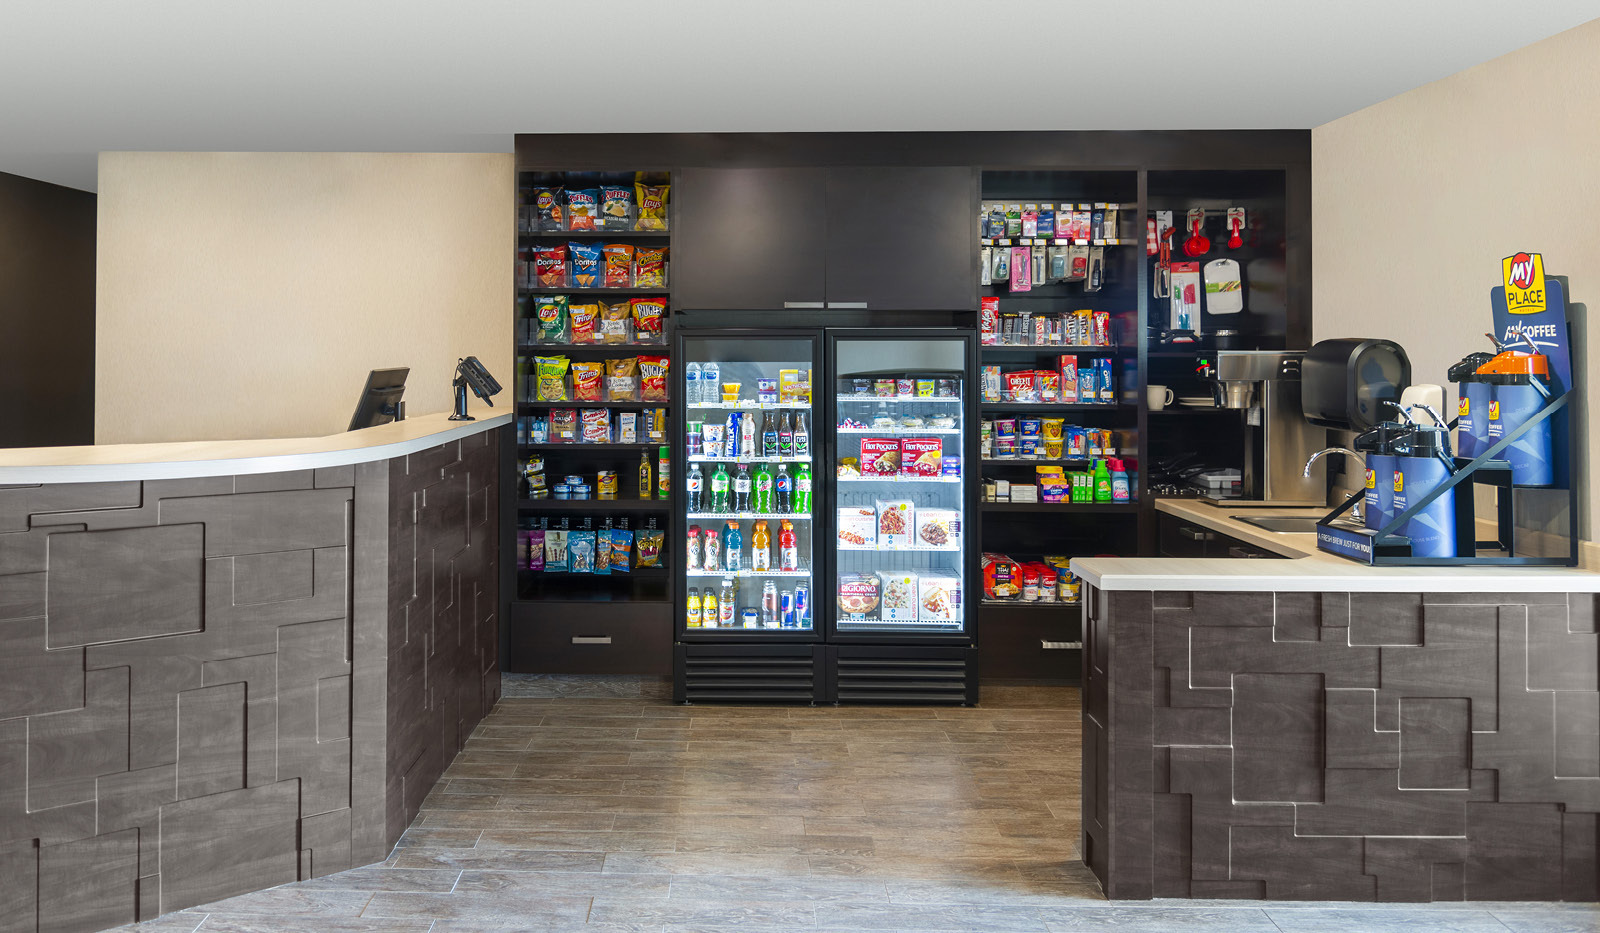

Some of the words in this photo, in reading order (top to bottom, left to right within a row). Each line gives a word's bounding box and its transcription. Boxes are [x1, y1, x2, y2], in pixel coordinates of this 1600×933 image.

[569, 194, 593, 203] RUFFLES
[605, 190, 630, 200] RUFFLES
[643, 200, 661, 209] Lay's
[609, 253, 631, 264] Cheetos
[639, 252, 663, 267] Cheetos
[1508, 253, 1535, 286] MY
[1508, 290, 1544, 305] PLACE
[540, 308, 558, 318] Lay's
[636, 304, 663, 319] BUGLES
[574, 313, 592, 324] Fritos
[1521, 324, 1557, 338] COFFEE
[578, 370, 598, 381] Fritos
[640, 363, 666, 379] BUGLES
[1321, 534, 1333, 542] FRESH
[1333, 537, 1344, 546] BREW
[1343, 539, 1353, 548] JUST
[1352, 542, 1360, 550] FOR
